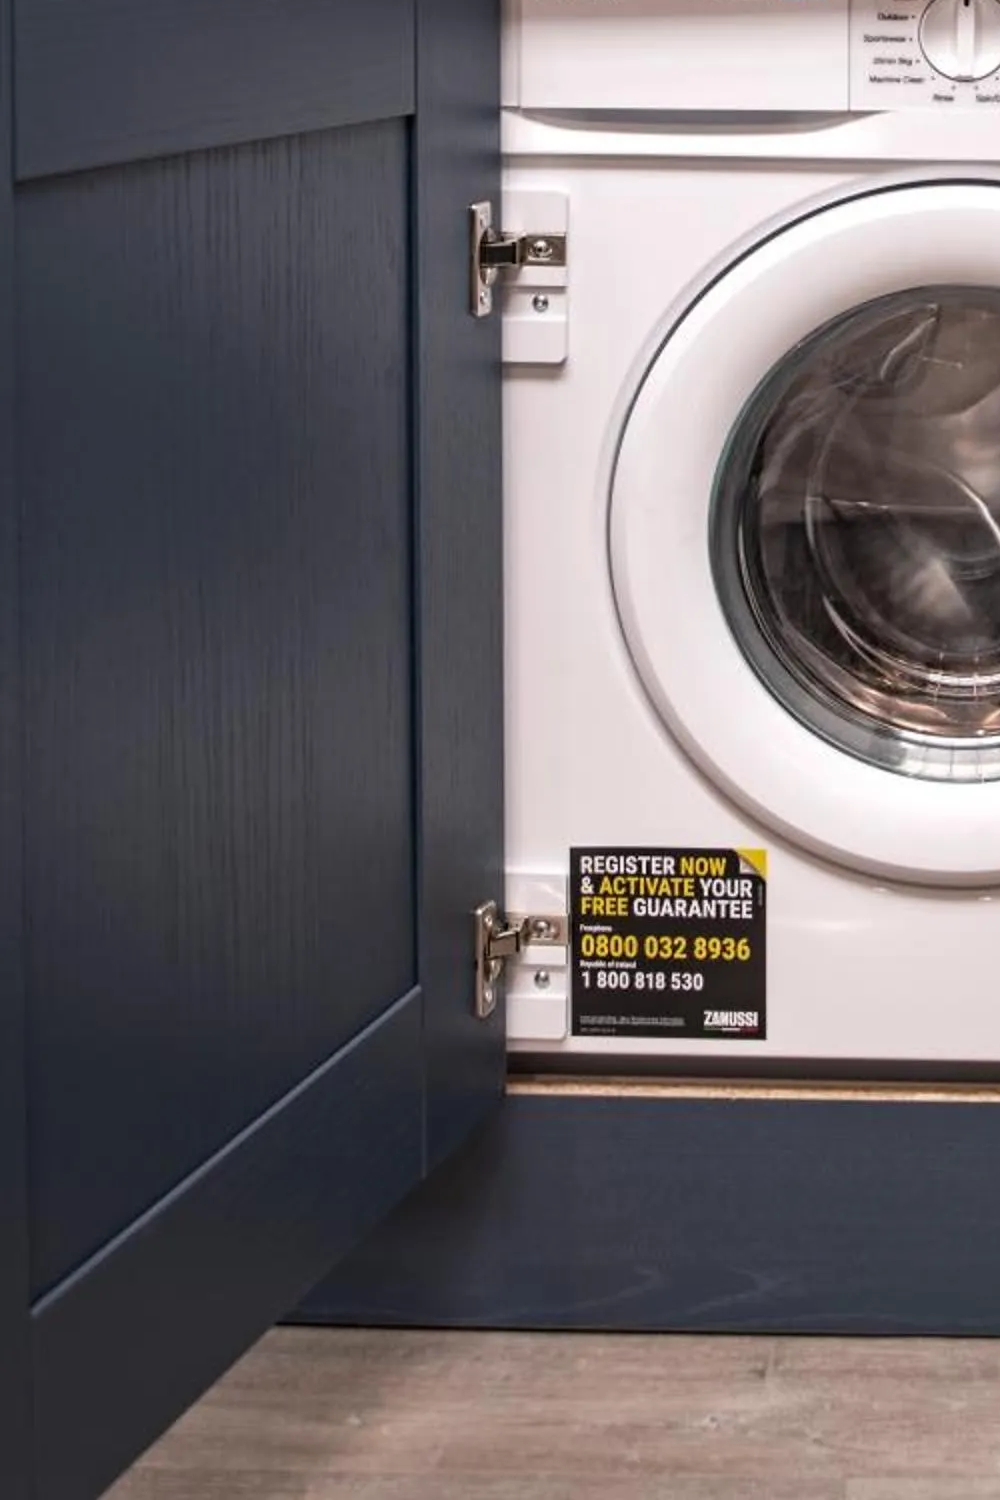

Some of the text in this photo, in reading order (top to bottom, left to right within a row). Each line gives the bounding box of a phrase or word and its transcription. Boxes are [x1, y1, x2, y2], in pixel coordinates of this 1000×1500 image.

[580, 855, 726, 876] REGISTER NOW
[580, 877, 594, 895] &
[599, 876, 695, 897] ACTIVATE
[700, 879, 753, 898] YOUR
[580, 897, 753, 919] FREE GUARANTEE
[581, 934, 751, 960] 0800 032 8936
[582, 971, 704, 991] 1 800 818 530
[703, 1010, 759, 1027] ZANUSSI
